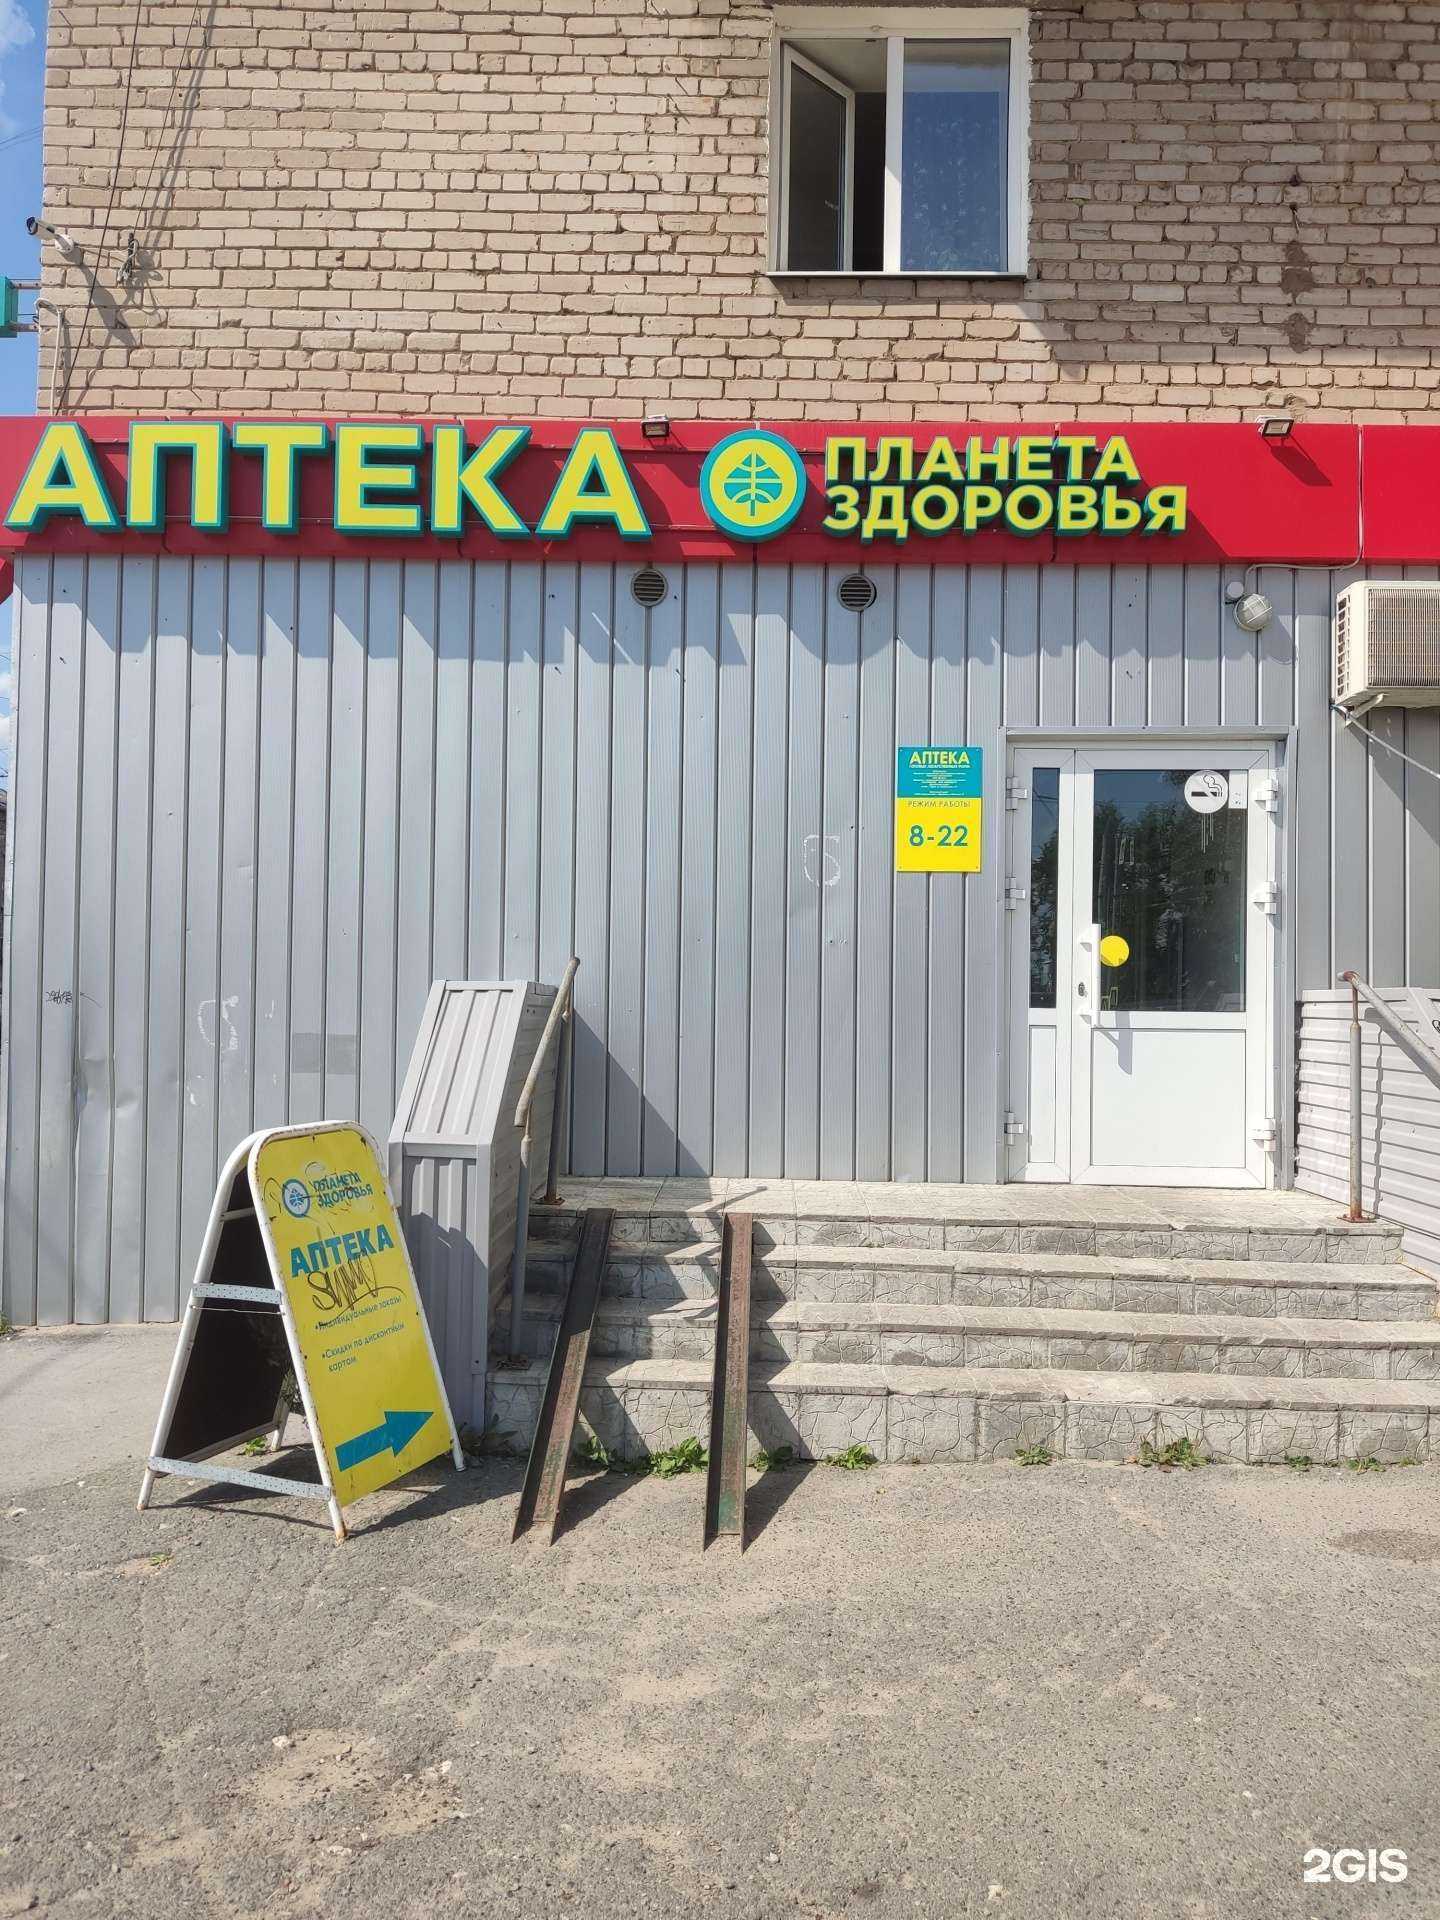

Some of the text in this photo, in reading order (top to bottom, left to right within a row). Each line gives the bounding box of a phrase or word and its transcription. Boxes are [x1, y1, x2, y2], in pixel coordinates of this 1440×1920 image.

[823, 434, 1141, 485] ПЛАНЕТА
[3, 420, 653, 541] АПТЕКА
[822, 485, 1189, 541] ЗДОРОВЬЯ
[909, 751, 970, 765] АПТЕКА
[908, 800, 971, 808] РЕЖИМ РАБОТЫ
[909, 824, 968, 847] 8-22
[317, 1183, 374, 1209] ЗДОРОВЬЯ
[290, 1223, 395, 1279] АПТЕКА
